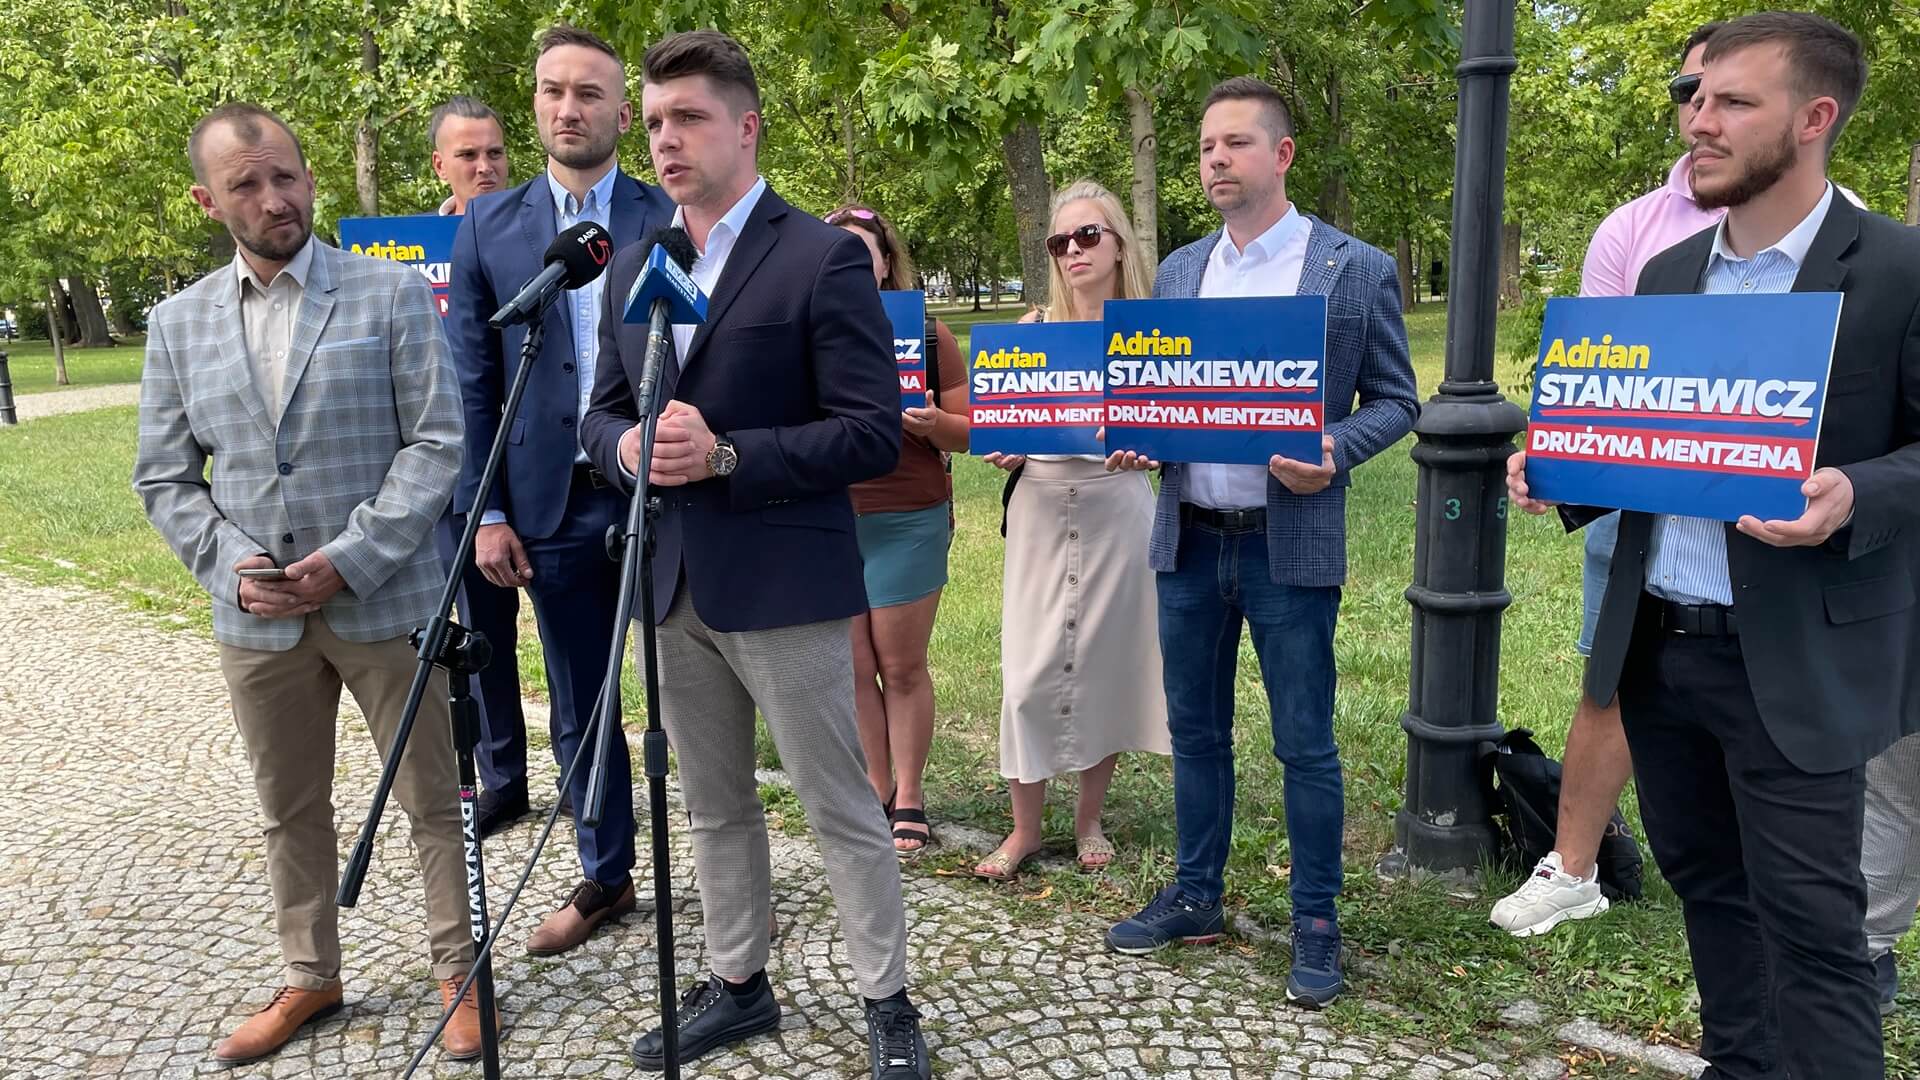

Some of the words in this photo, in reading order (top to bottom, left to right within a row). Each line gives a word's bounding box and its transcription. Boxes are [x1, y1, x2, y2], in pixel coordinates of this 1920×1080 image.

[350, 240, 425, 261] Adrian
[1107, 328, 1192, 356] Adrian
[1542, 334, 1650, 369] Adrian
[973, 346, 1047, 369] Adrian
[1108, 360, 1319, 388] STANKIEWICZ
[1537, 373, 1817, 418] STANKIEWICZ
[973, 404, 1051, 423] DRUŻYNA
[1055, 408, 1104, 423] MENT
[1108, 401, 1200, 424] DRUŻYNA
[1203, 407, 1317, 426] MENTZENA
[1532, 426, 1646, 459] DRUŻYNA
[1650, 438, 1803, 472] MENTZENA
[1445, 498, 1461, 520] 3
[1496, 497, 1508, 519] 5
